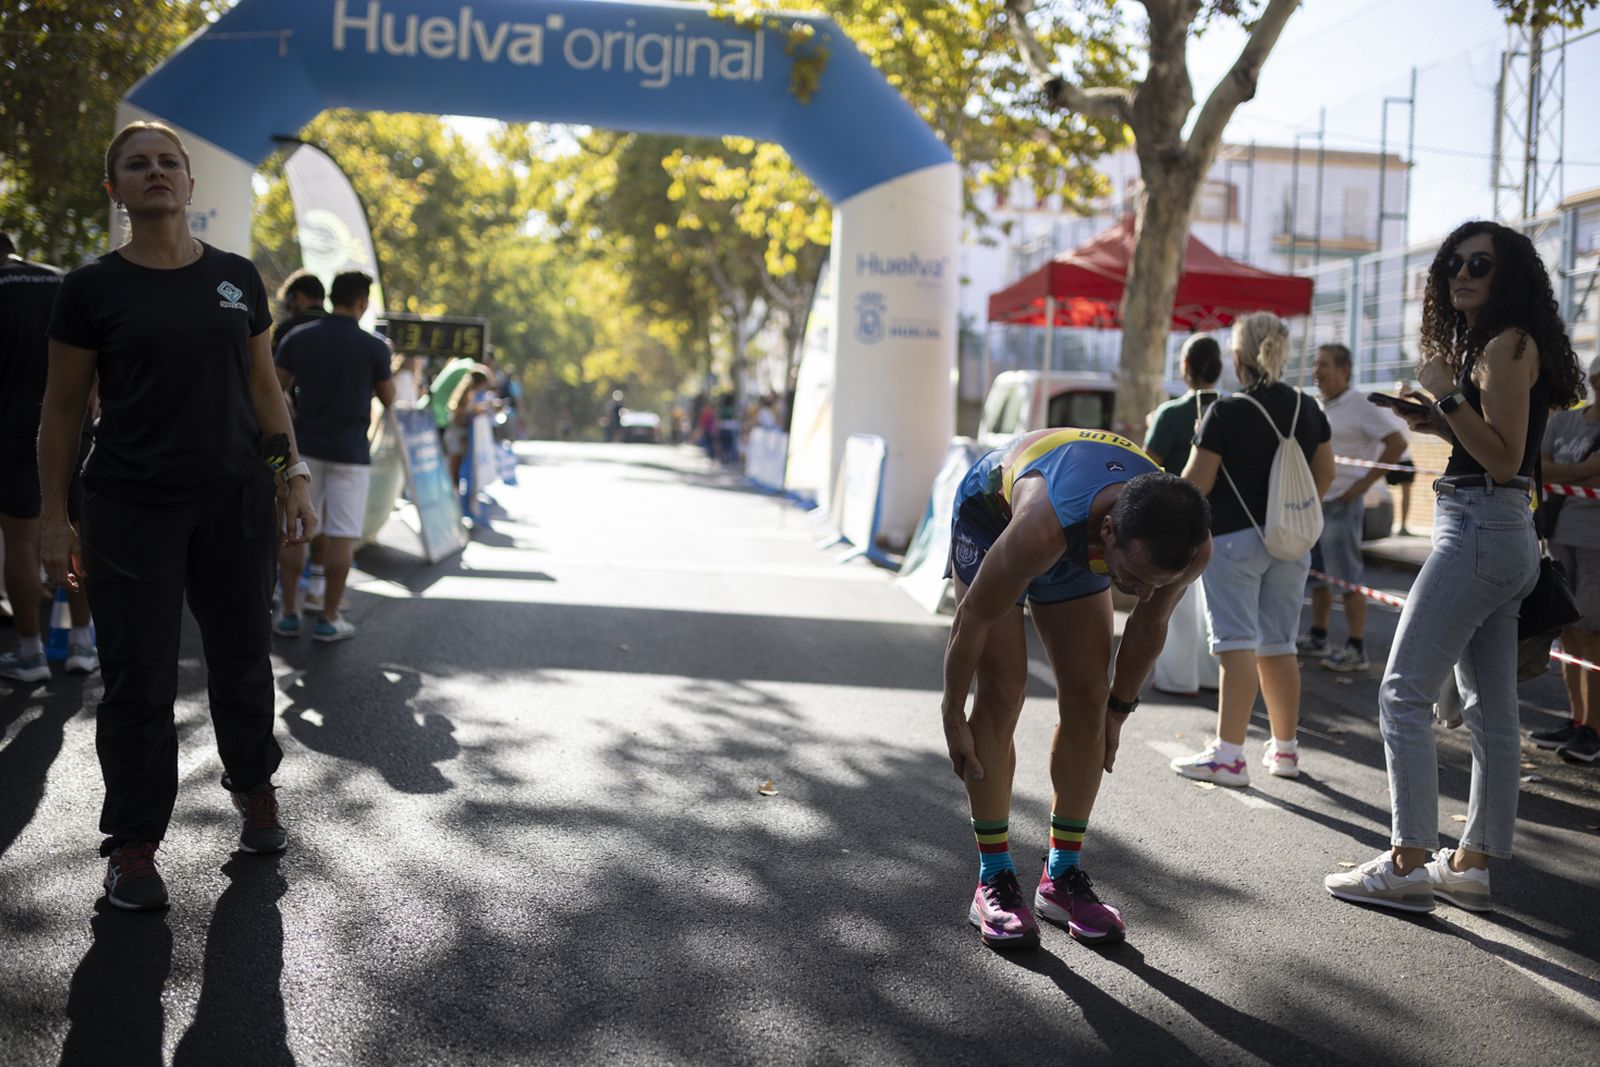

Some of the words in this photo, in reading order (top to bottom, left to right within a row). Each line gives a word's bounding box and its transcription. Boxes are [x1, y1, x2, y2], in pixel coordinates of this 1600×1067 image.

[332, 0, 544, 65] Huelva
[563, 18, 765, 88] original
[856, 252, 945, 278] Huelva
[1078, 430, 1132, 447] CLUB
